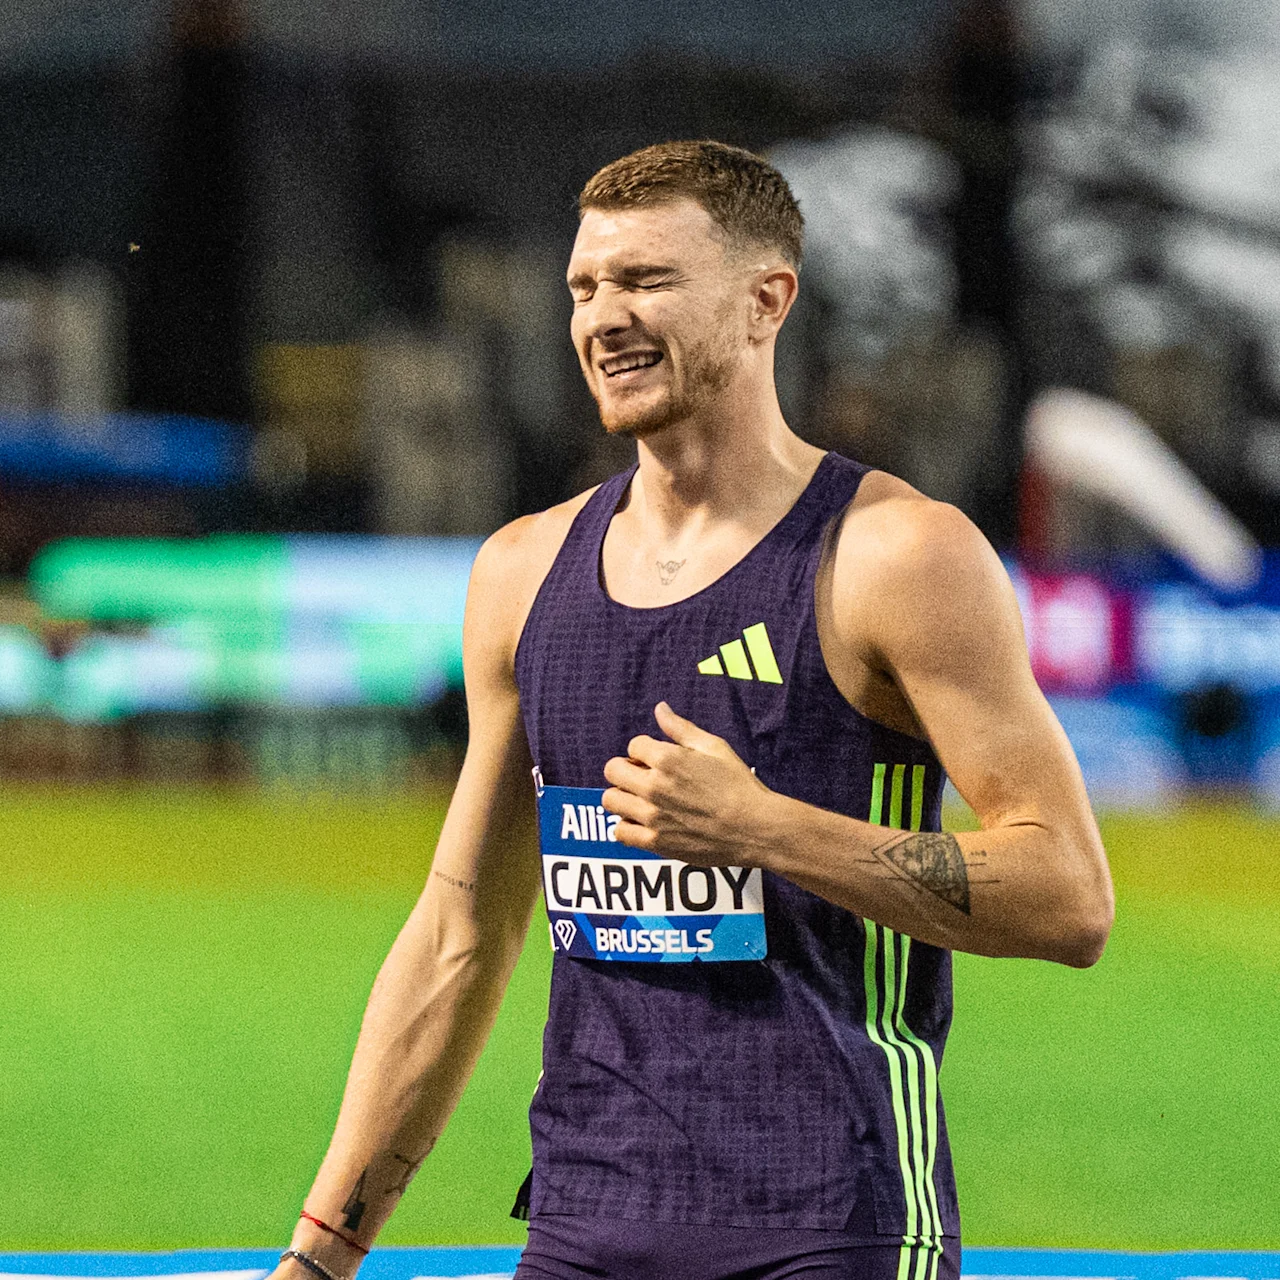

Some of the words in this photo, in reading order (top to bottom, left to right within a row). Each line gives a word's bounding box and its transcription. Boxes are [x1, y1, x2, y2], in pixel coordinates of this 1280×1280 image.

[561, 803, 620, 842] Allia
[551, 861, 752, 911] CARMOY
[595, 927, 714, 953] BRUSSELS
